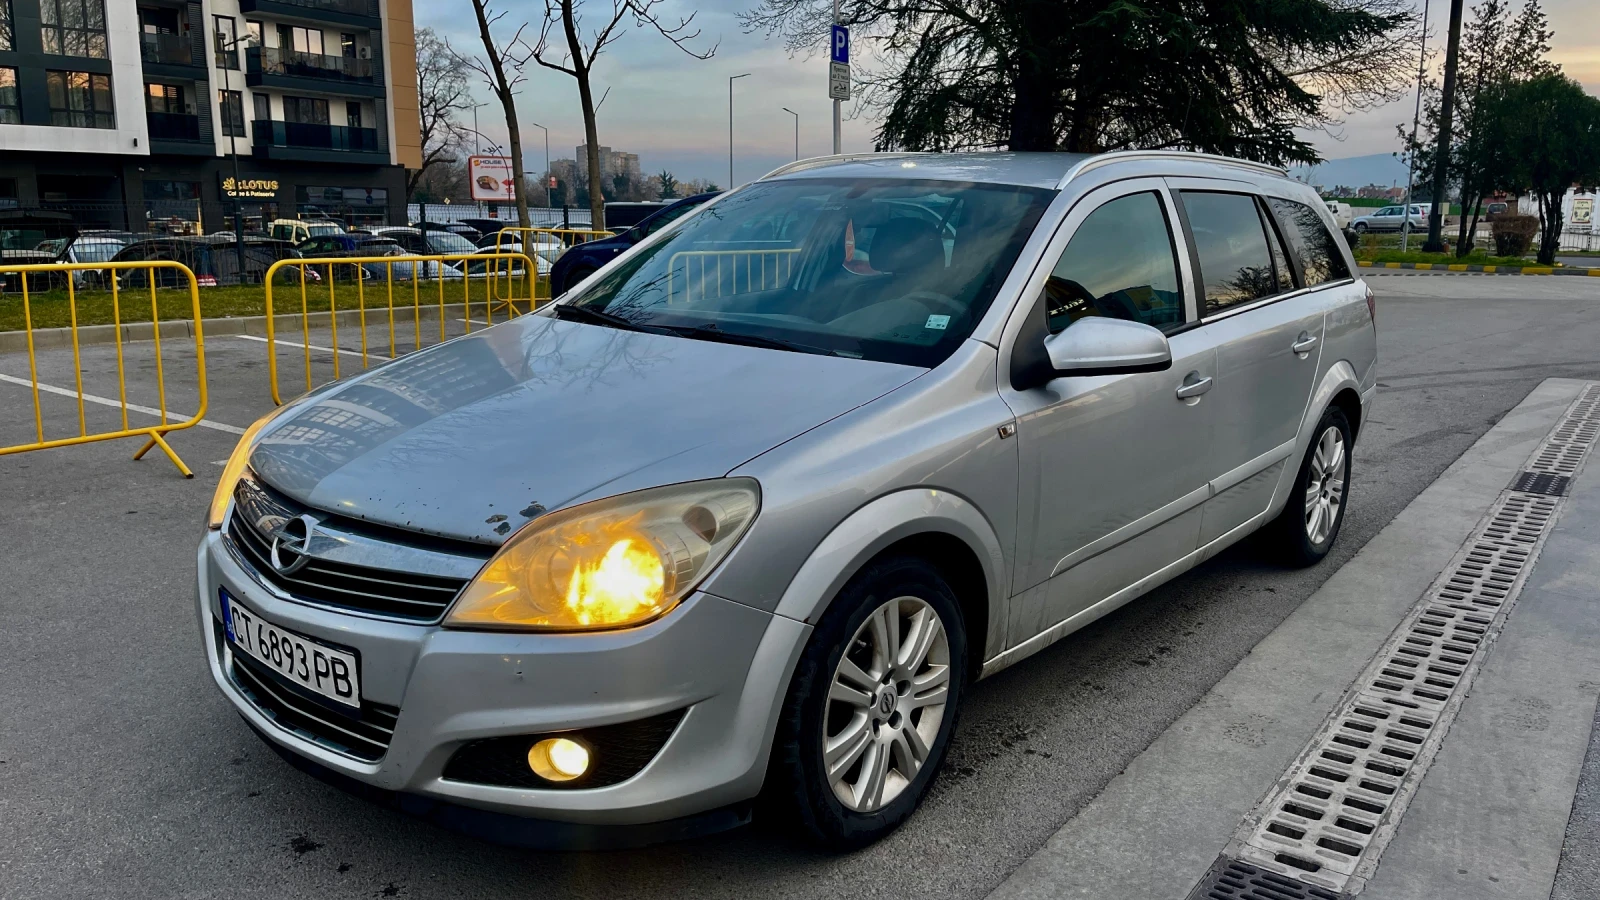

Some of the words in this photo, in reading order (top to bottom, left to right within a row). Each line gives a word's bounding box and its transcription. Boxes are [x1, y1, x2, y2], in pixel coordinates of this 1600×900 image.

[836, 30, 846, 57] P
[257, 623, 310, 682] 6893
[313, 649, 353, 698] PB
